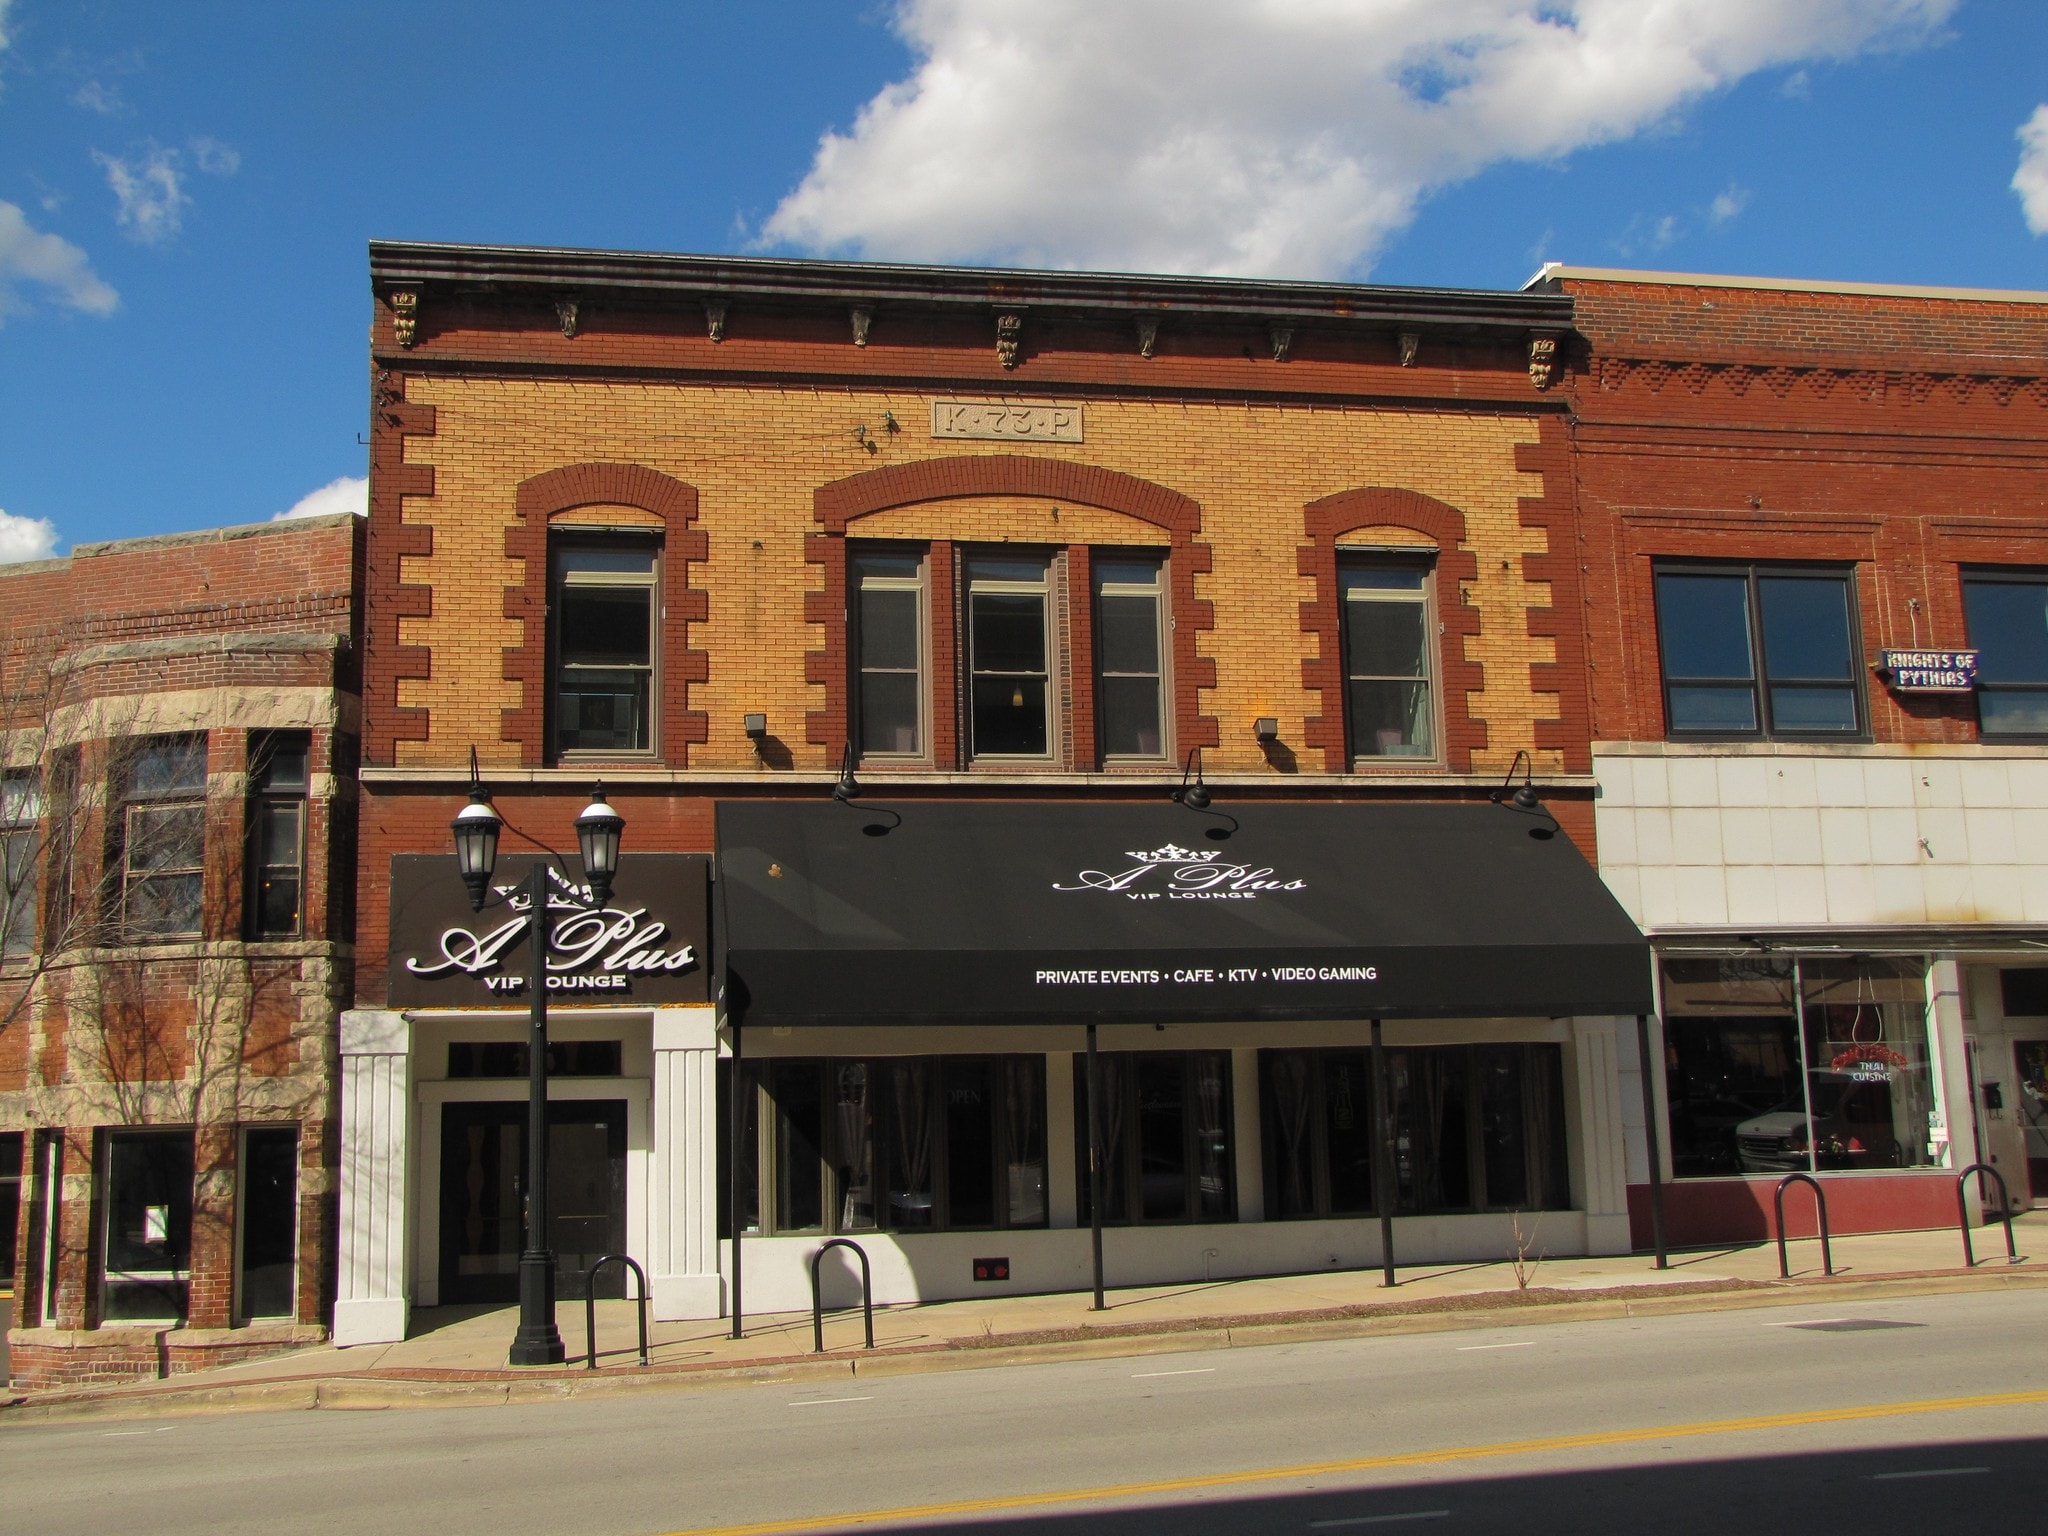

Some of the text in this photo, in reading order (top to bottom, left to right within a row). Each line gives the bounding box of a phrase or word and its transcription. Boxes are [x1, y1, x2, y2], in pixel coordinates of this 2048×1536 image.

[1887, 653, 1975, 669] KNIGHTS OF
[1899, 670, 1967, 686] PYTHIAS
[1051, 863, 1307, 892] A Plus
[1126, 892, 1257, 901] VIP LOUNGE
[406, 907, 695, 973] A Plus
[484, 974, 627, 990] VIP OUNGE
[1035, 967, 1377, 984] PRIVATE EVENTS CAFE KTV VIDEO GAMING
[1859, 1062, 1884, 1071] THAI
